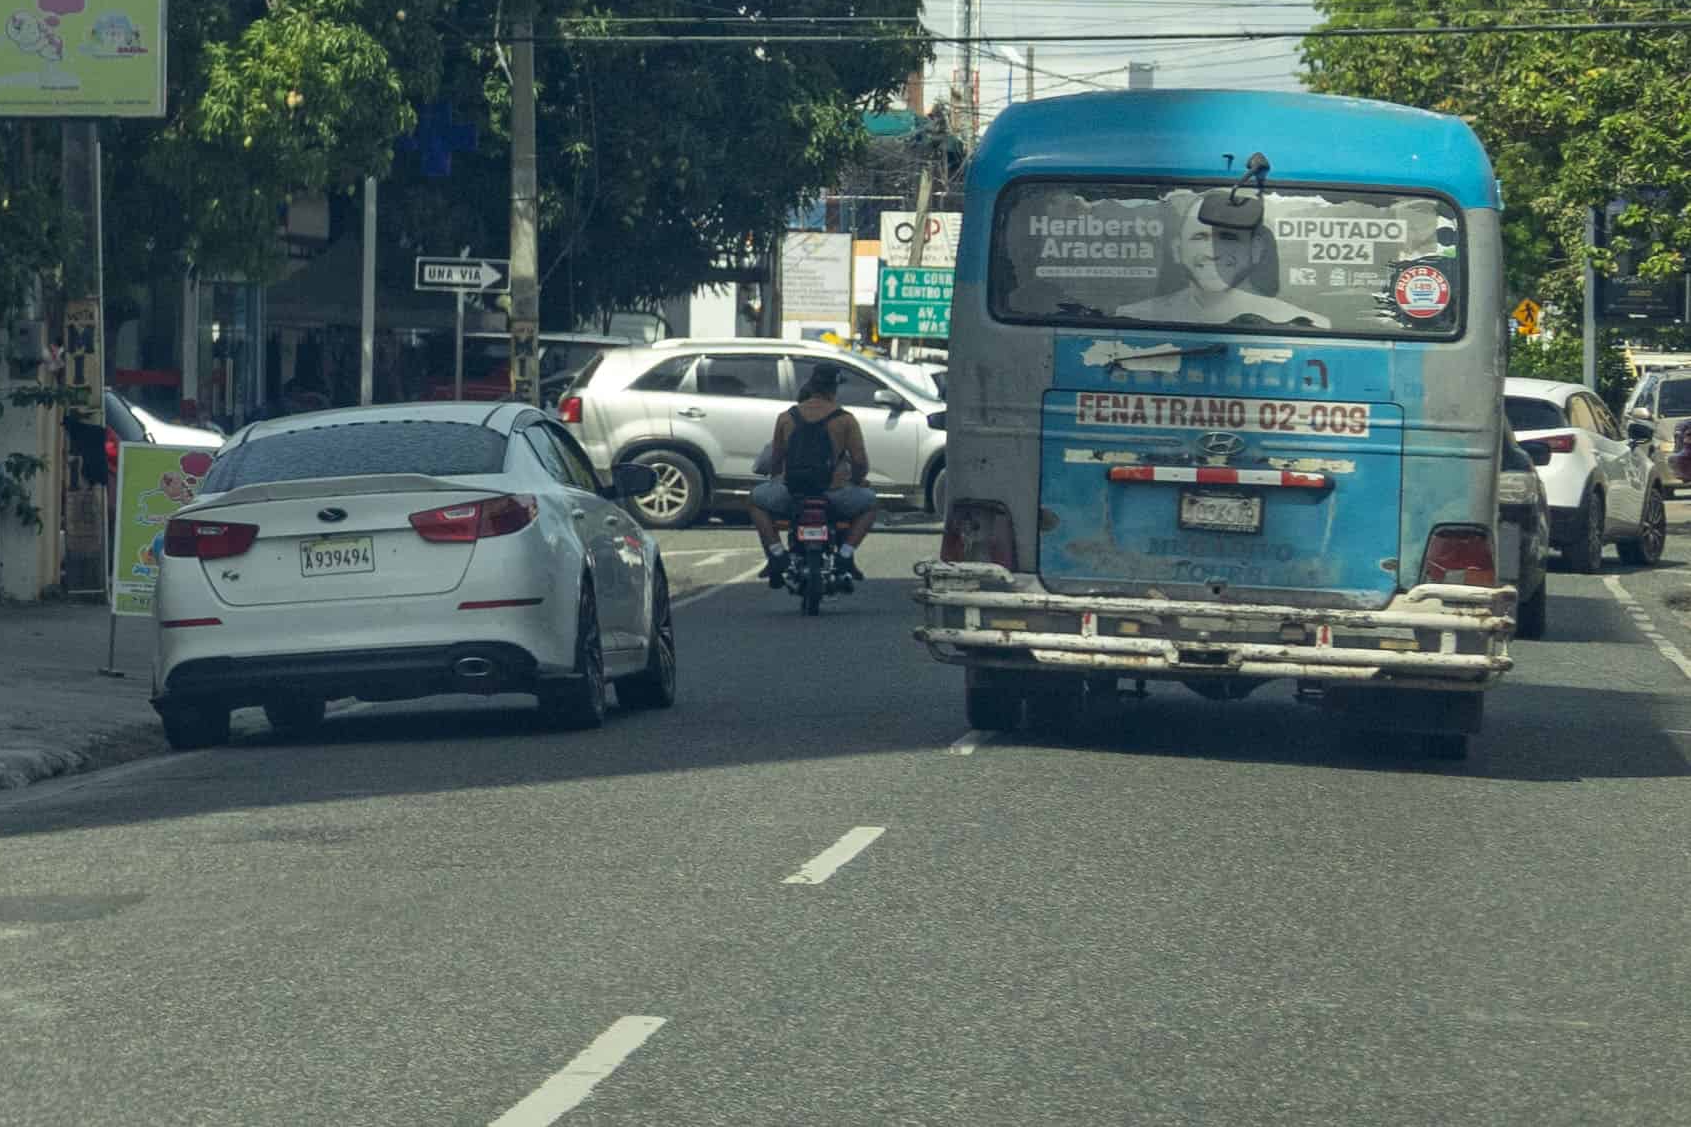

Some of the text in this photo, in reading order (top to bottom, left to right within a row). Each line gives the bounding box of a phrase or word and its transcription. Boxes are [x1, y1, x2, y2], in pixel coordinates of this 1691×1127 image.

[1029, 214, 1164, 237] Heriberto
[1277, 220, 1403, 240] DIPUTADO
[1041, 237, 1156, 259] Aracena
[1311, 242, 1370, 262] 2024
[427, 265, 482, 281] UNA VIA
[1078, 393, 1246, 429] FENATRANO
